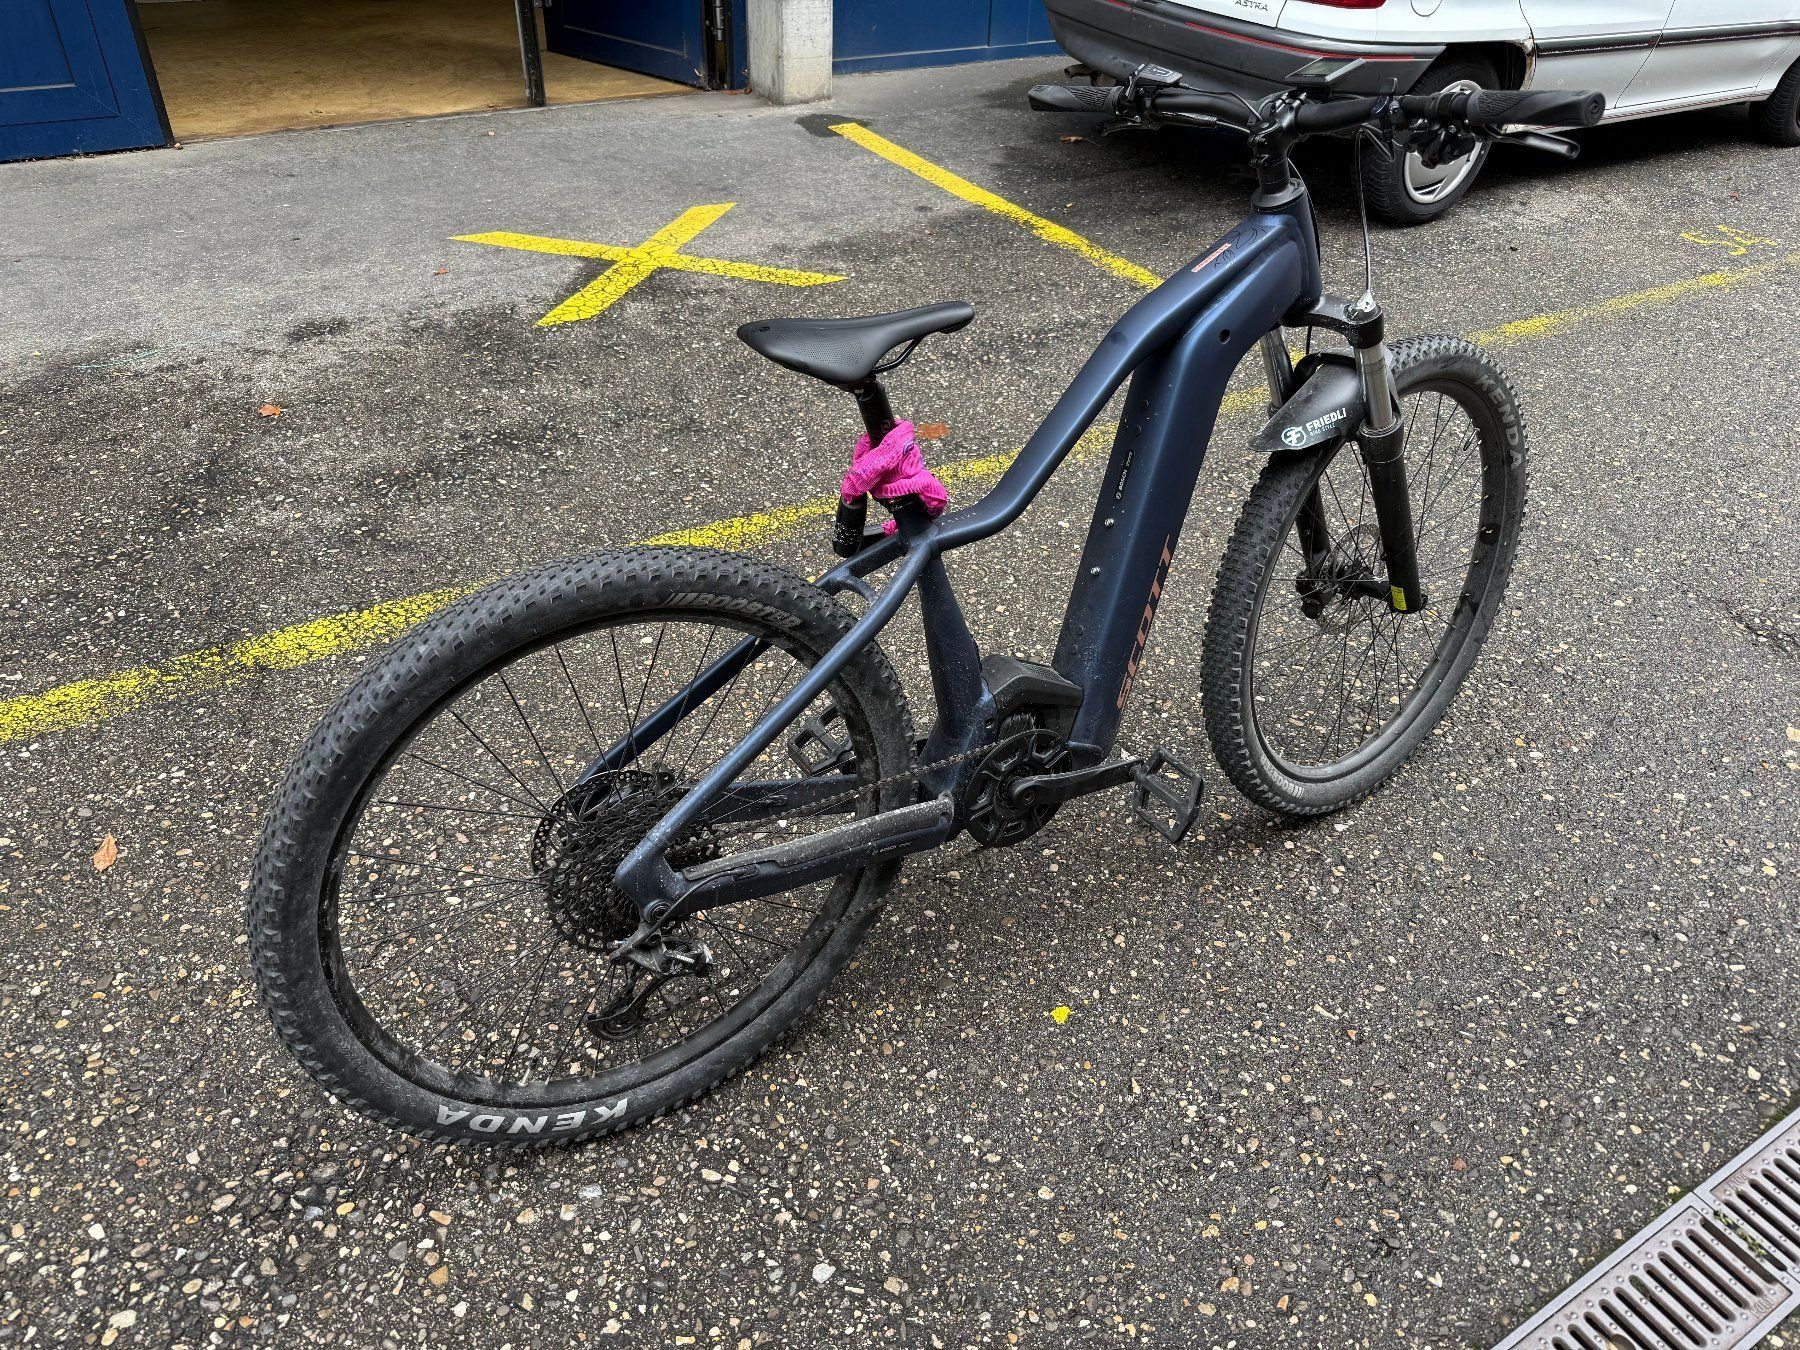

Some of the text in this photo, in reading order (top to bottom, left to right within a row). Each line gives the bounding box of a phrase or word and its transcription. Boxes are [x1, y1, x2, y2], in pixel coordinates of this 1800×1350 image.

[1234, 0, 1268, 11] ASTRA
[1305, 407, 1347, 432] FRIEDLI
[1474, 374, 1522, 470] KENDA
[1117, 533, 1171, 715] SCOTT
[435, 1098, 628, 1134] KENDA
